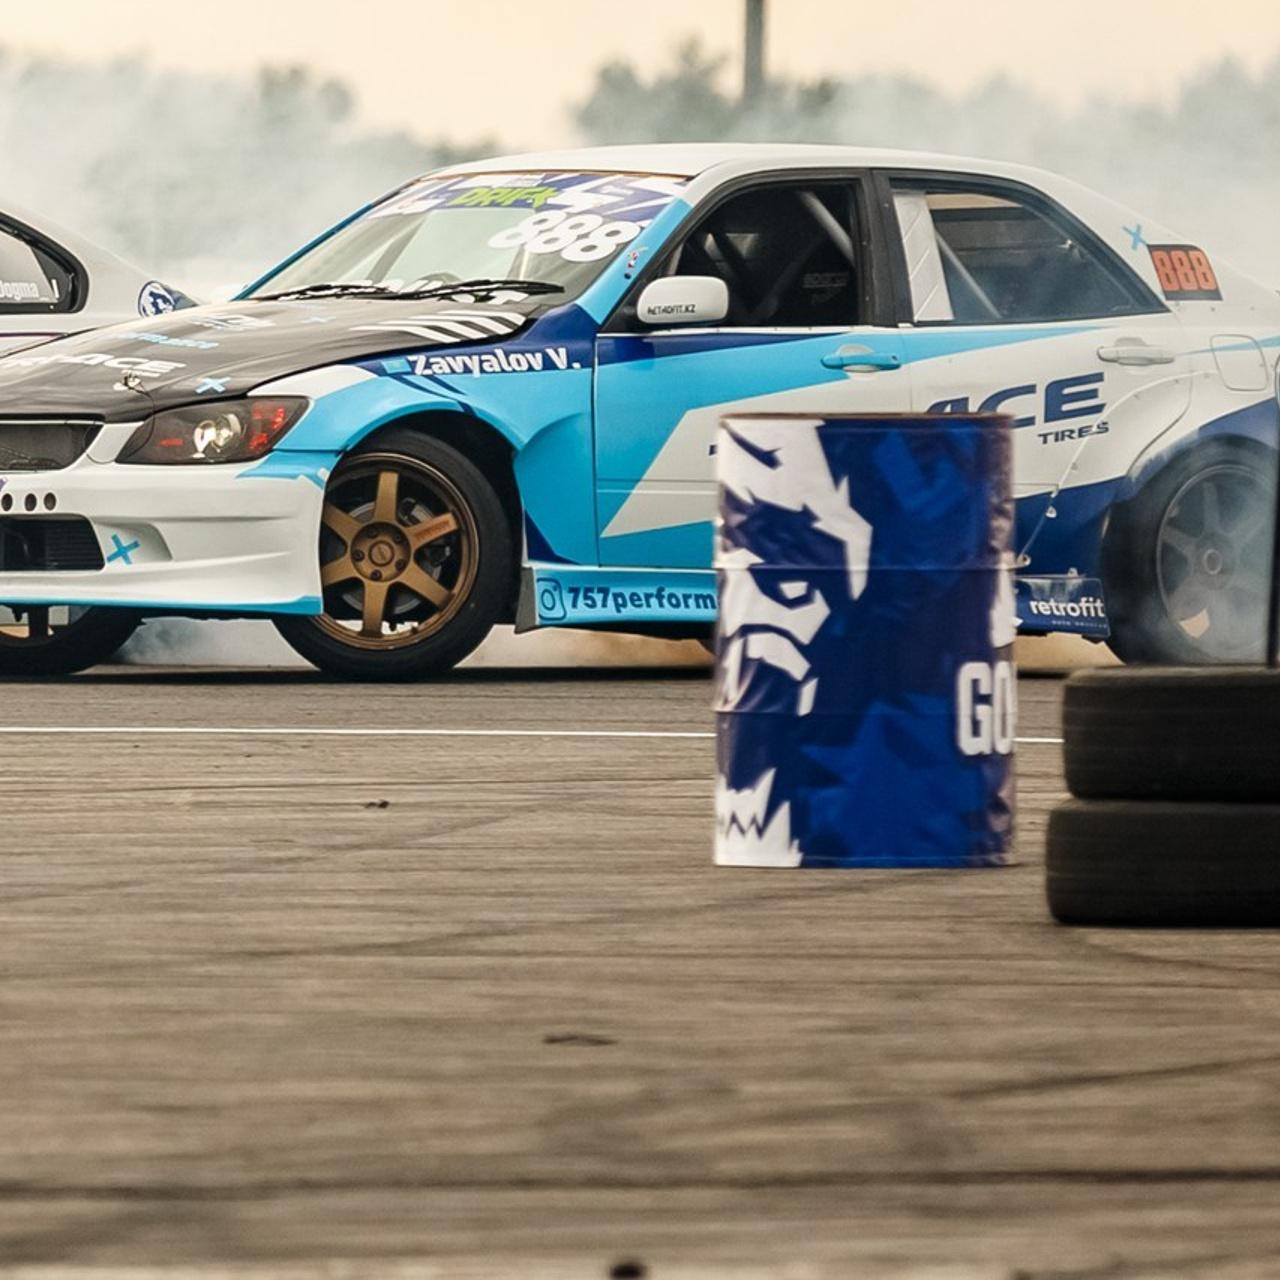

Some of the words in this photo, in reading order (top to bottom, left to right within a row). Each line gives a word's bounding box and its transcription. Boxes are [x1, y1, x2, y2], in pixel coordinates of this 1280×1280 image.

[488, 210, 641, 262] 888
[1151, 249, 1219, 291] 888
[407, 347, 543, 378] Zavyalov
[545, 346, 582, 371] V.
[1037, 420, 1110, 446] TIRES
[1029, 596, 1106, 618] retrofit
